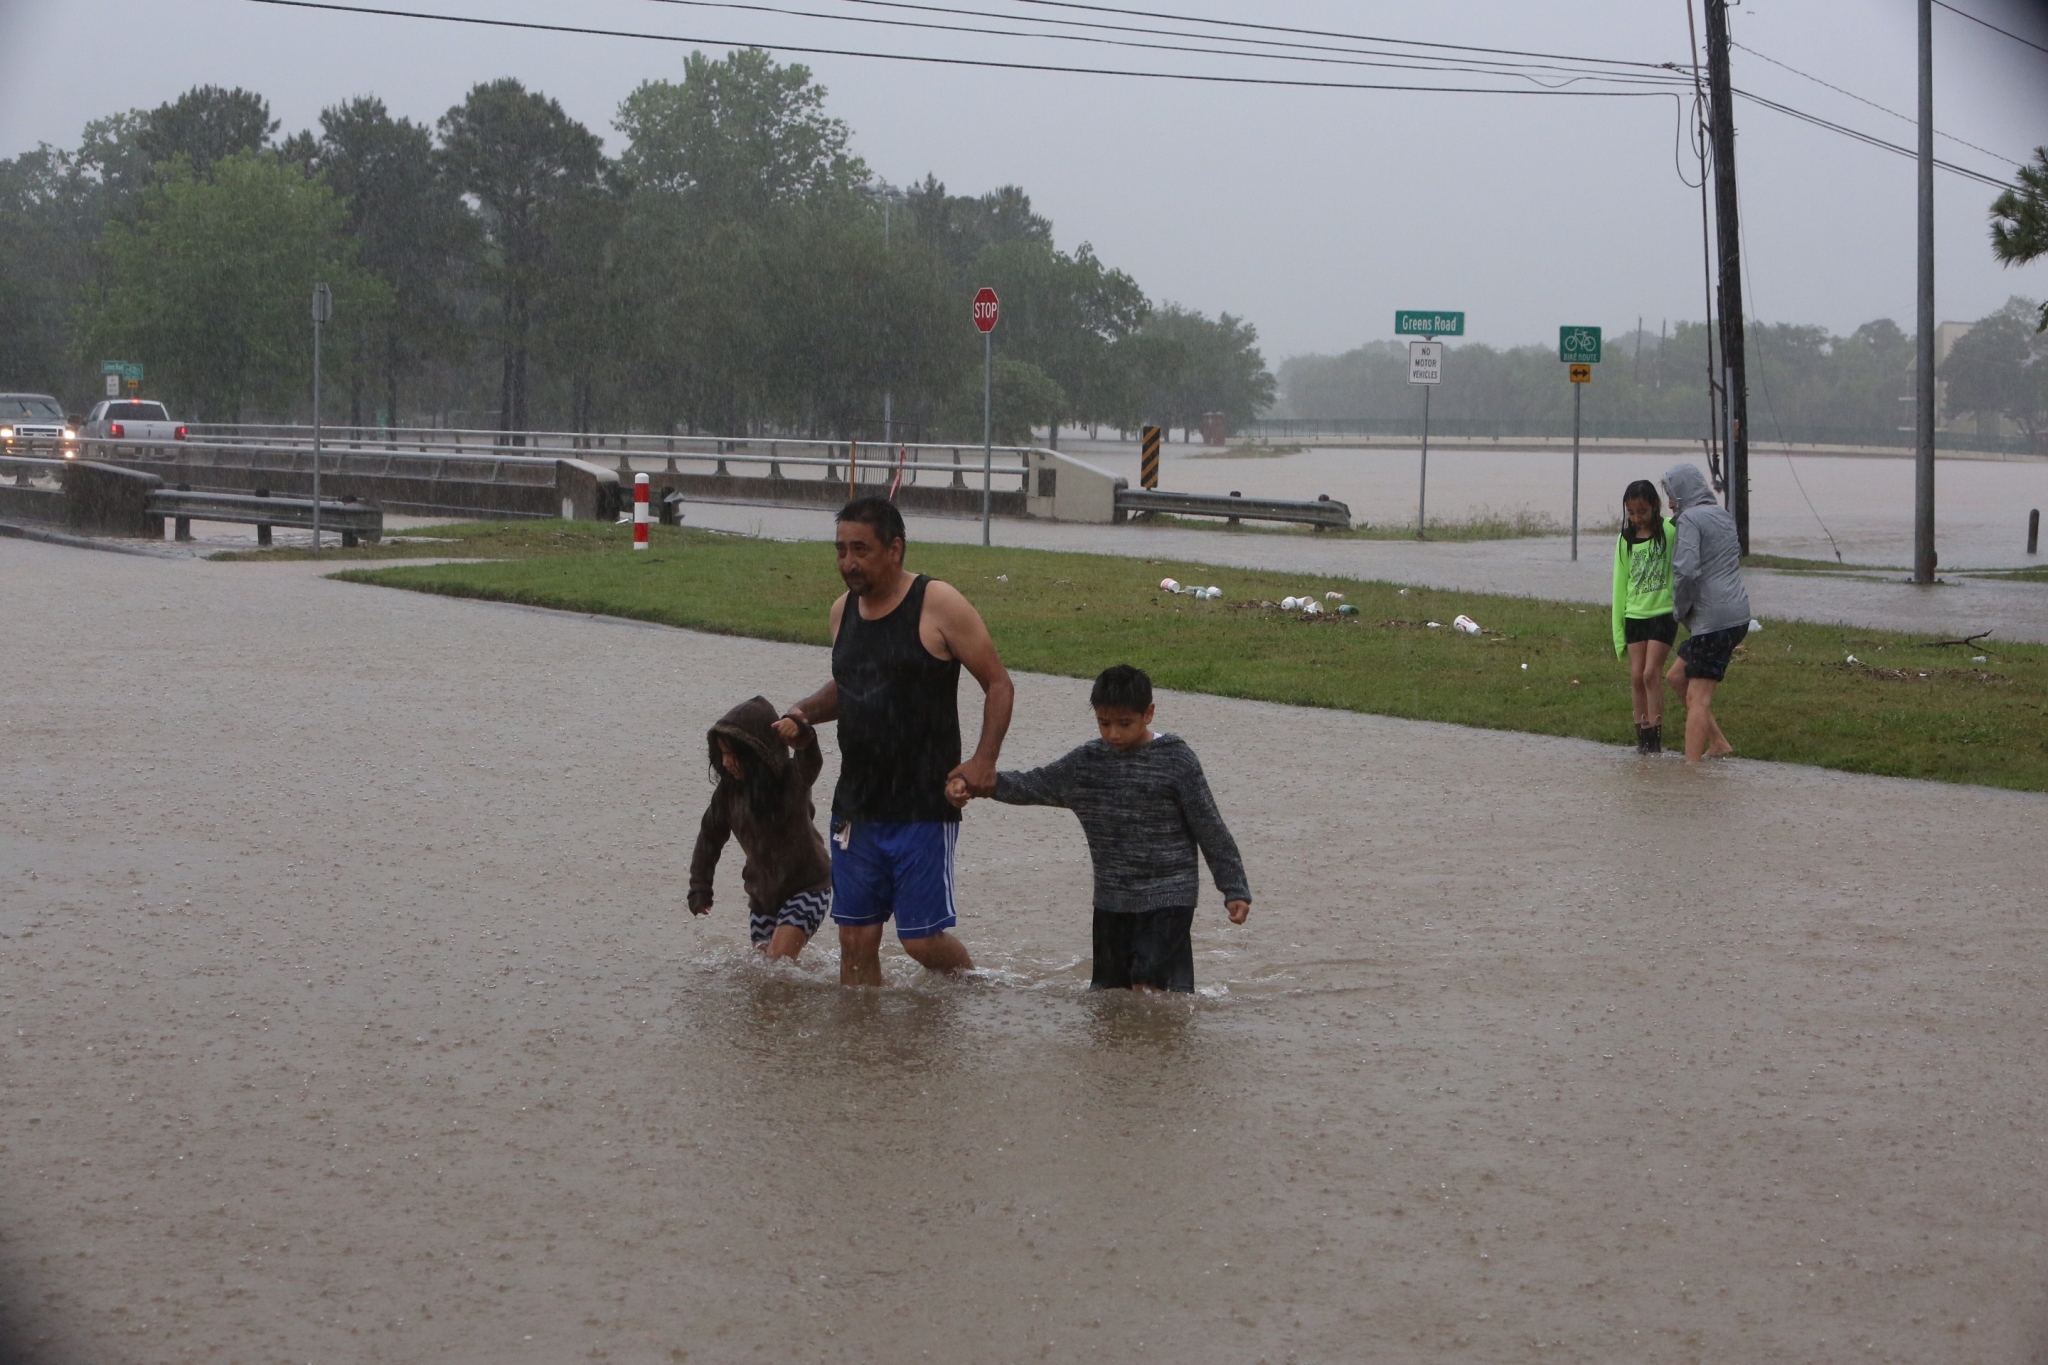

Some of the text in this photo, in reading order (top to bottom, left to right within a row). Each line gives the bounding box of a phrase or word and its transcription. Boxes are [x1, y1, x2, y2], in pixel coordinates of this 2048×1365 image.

[974, 302, 997, 319] STOP
[1402, 314, 1456, 332] Greens Road
[1421, 347, 1431, 356] NO
[1414, 358, 1437, 368] MOTOR
[1412, 370, 1438, 379] VEHICLES
